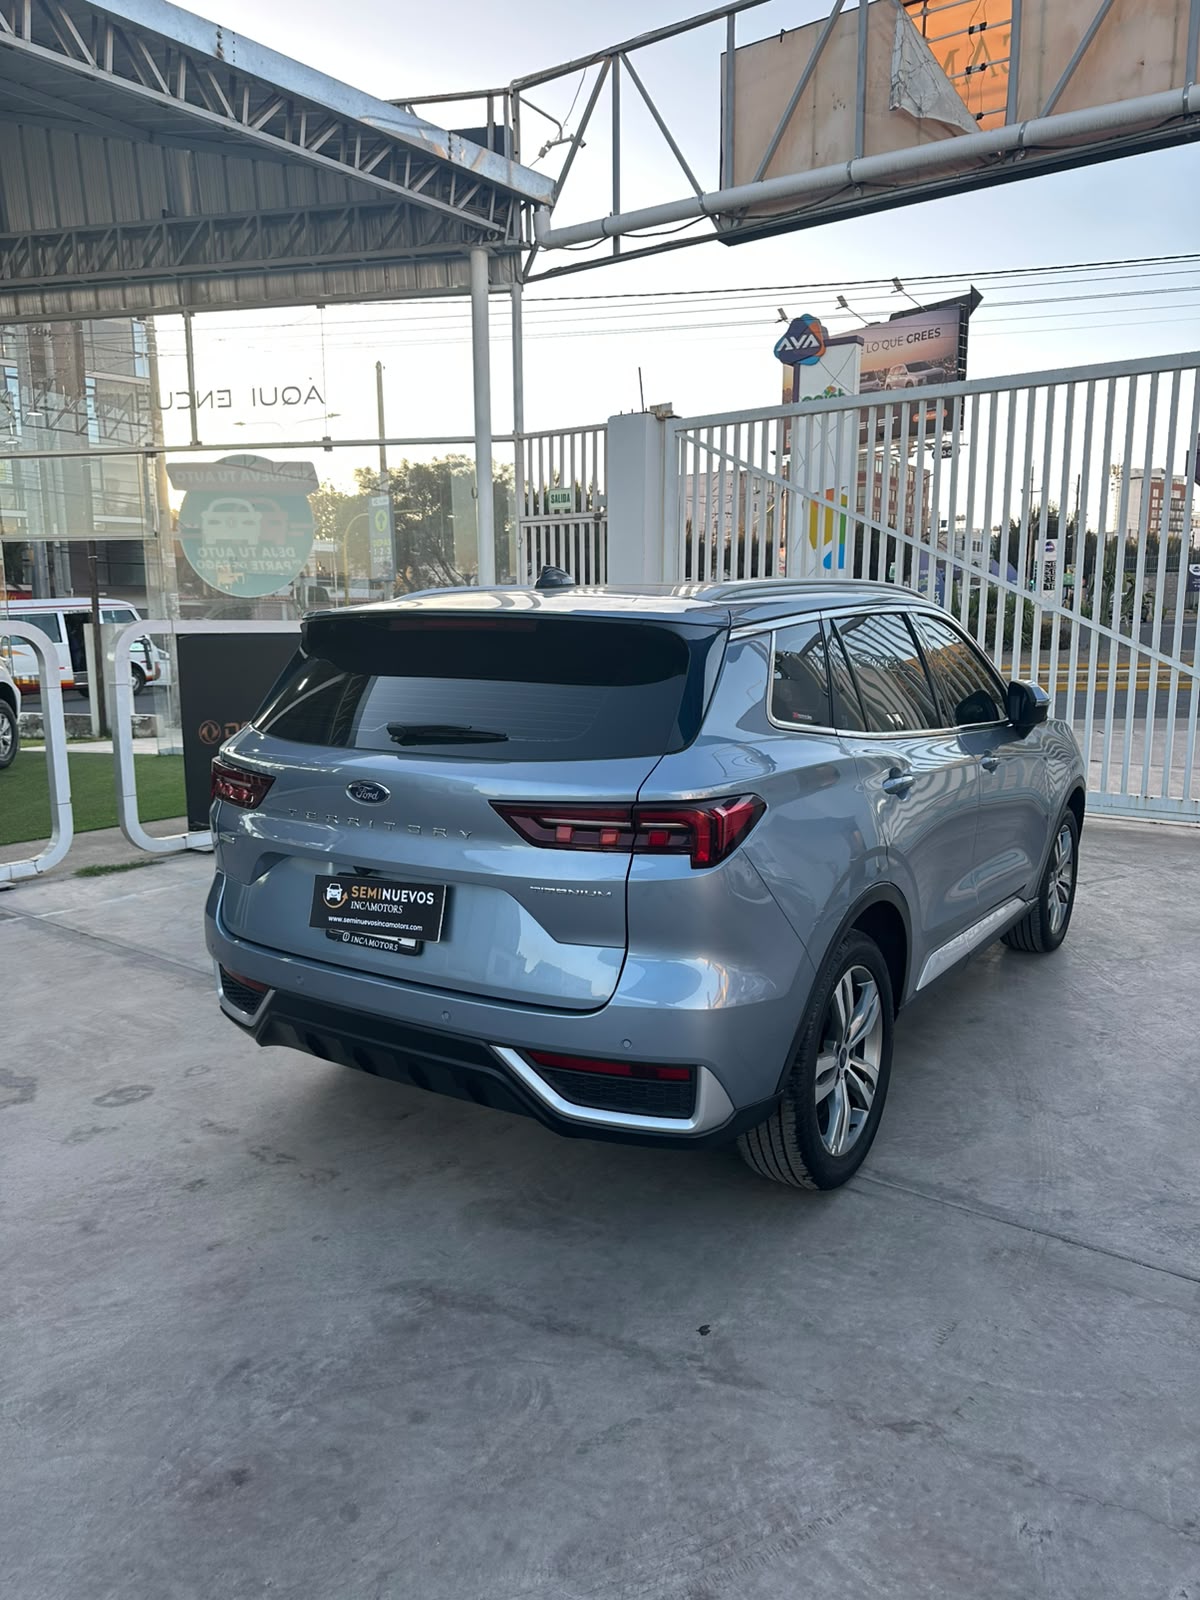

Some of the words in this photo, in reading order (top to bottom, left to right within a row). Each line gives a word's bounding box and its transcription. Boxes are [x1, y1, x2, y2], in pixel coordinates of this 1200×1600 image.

[777, 333, 820, 352] AVA
[866, 342, 880, 354] LO
[881, 336, 904, 350] QUE
[906, 327, 941, 344] CREES
[550, 493, 571, 504] SALIDA
[356, 785, 380, 801] Ford
[288, 808, 472, 840] TERRITORY
[351, 885, 435, 905] SEMINUEVOS
[529, 886, 612, 898] TITANIUM
[350, 900, 404, 914] INCAMOTORS
[328, 915, 423, 932] www.seminuevosincamotors.com
[350, 935, 399, 952] INCAMOTORS
